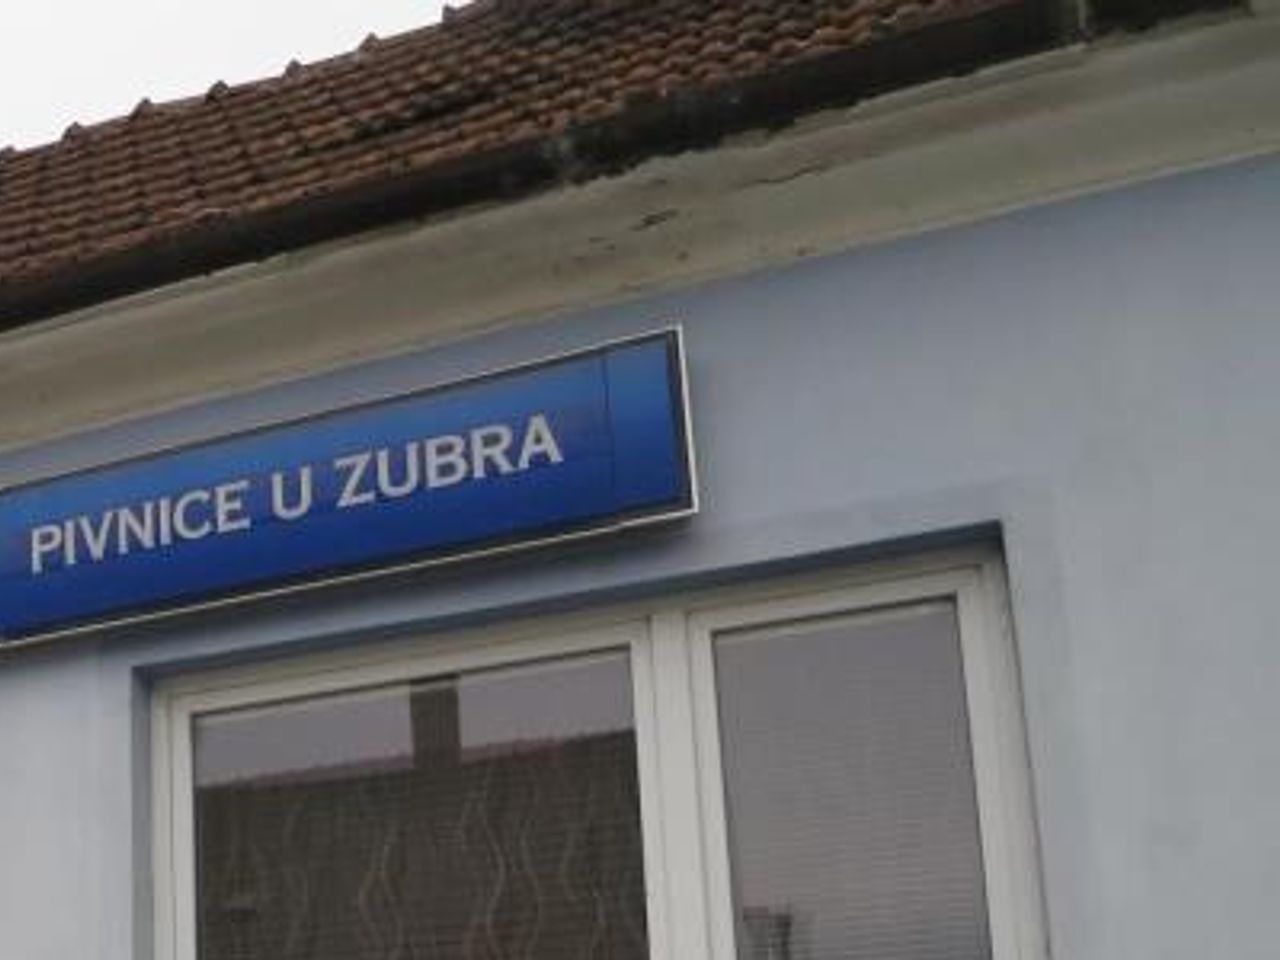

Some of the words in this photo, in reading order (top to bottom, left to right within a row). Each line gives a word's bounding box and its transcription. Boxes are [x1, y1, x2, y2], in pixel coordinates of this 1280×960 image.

[30, 479, 252, 574] PIVNICE
[271, 466, 312, 521] U
[334, 412, 564, 508] ZUBRA
